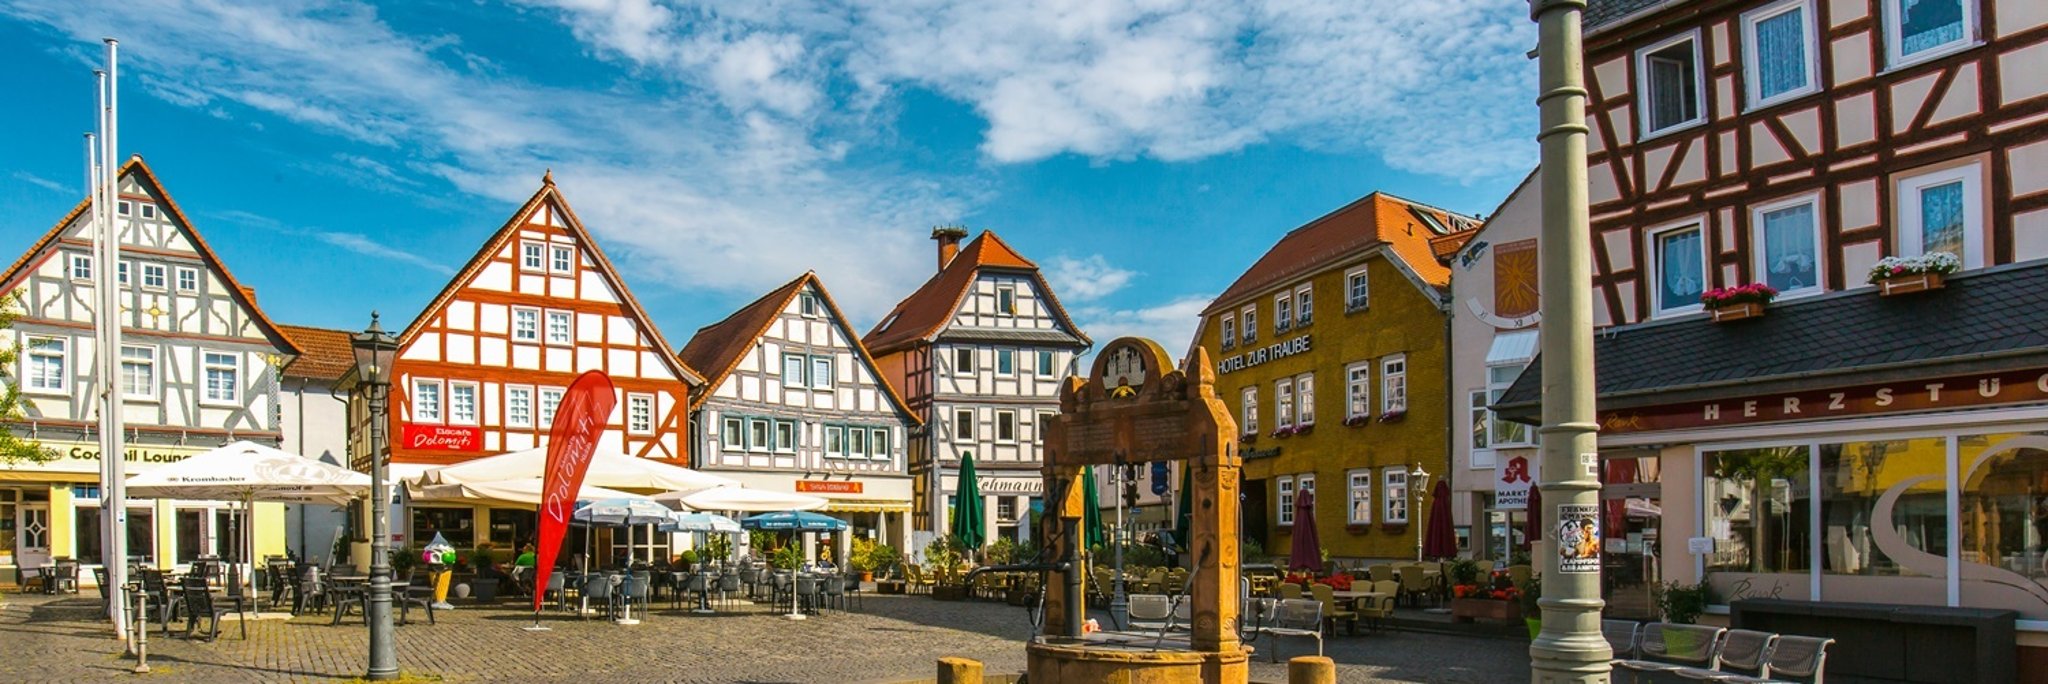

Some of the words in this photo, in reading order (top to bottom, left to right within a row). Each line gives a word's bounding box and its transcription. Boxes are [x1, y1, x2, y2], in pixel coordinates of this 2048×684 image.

[1217, 354, 1246, 374] HOTEL
[1247, 347, 1267, 367] ZUR
[1268, 335, 1311, 361] TRAUBE
[414, 434, 471, 448] Dolomiti
[143, 451, 192, 464] Loun
[549, 411, 595, 524] Dolomiti
[182, 475, 247, 483] Krombacher
